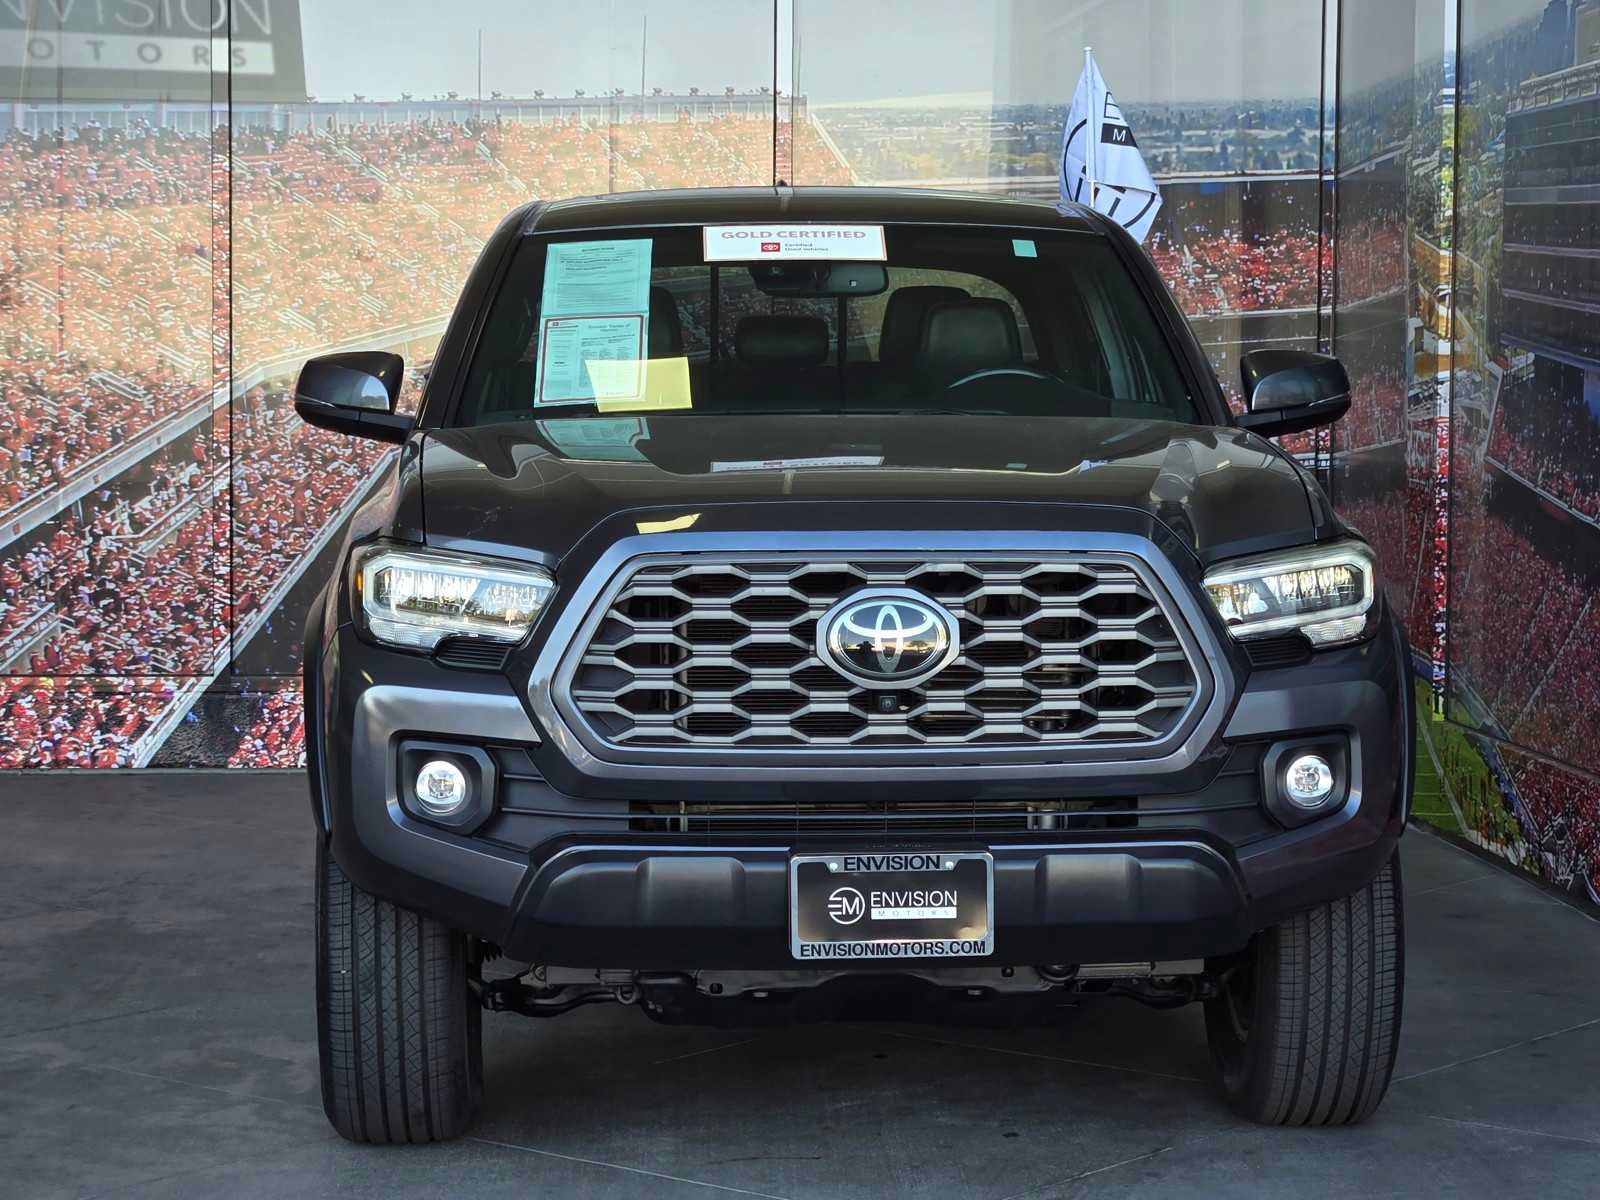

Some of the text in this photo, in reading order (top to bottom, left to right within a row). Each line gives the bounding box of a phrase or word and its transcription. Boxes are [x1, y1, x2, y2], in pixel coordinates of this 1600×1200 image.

[1112, 129, 1126, 142] M
[721, 230, 867, 239] GOLD CERTIFIED
[844, 855, 941, 871] ENVISION
[870, 890, 958, 907] ENVISION
[800, 941, 986, 957] ENVISIONMOTORS.COM
